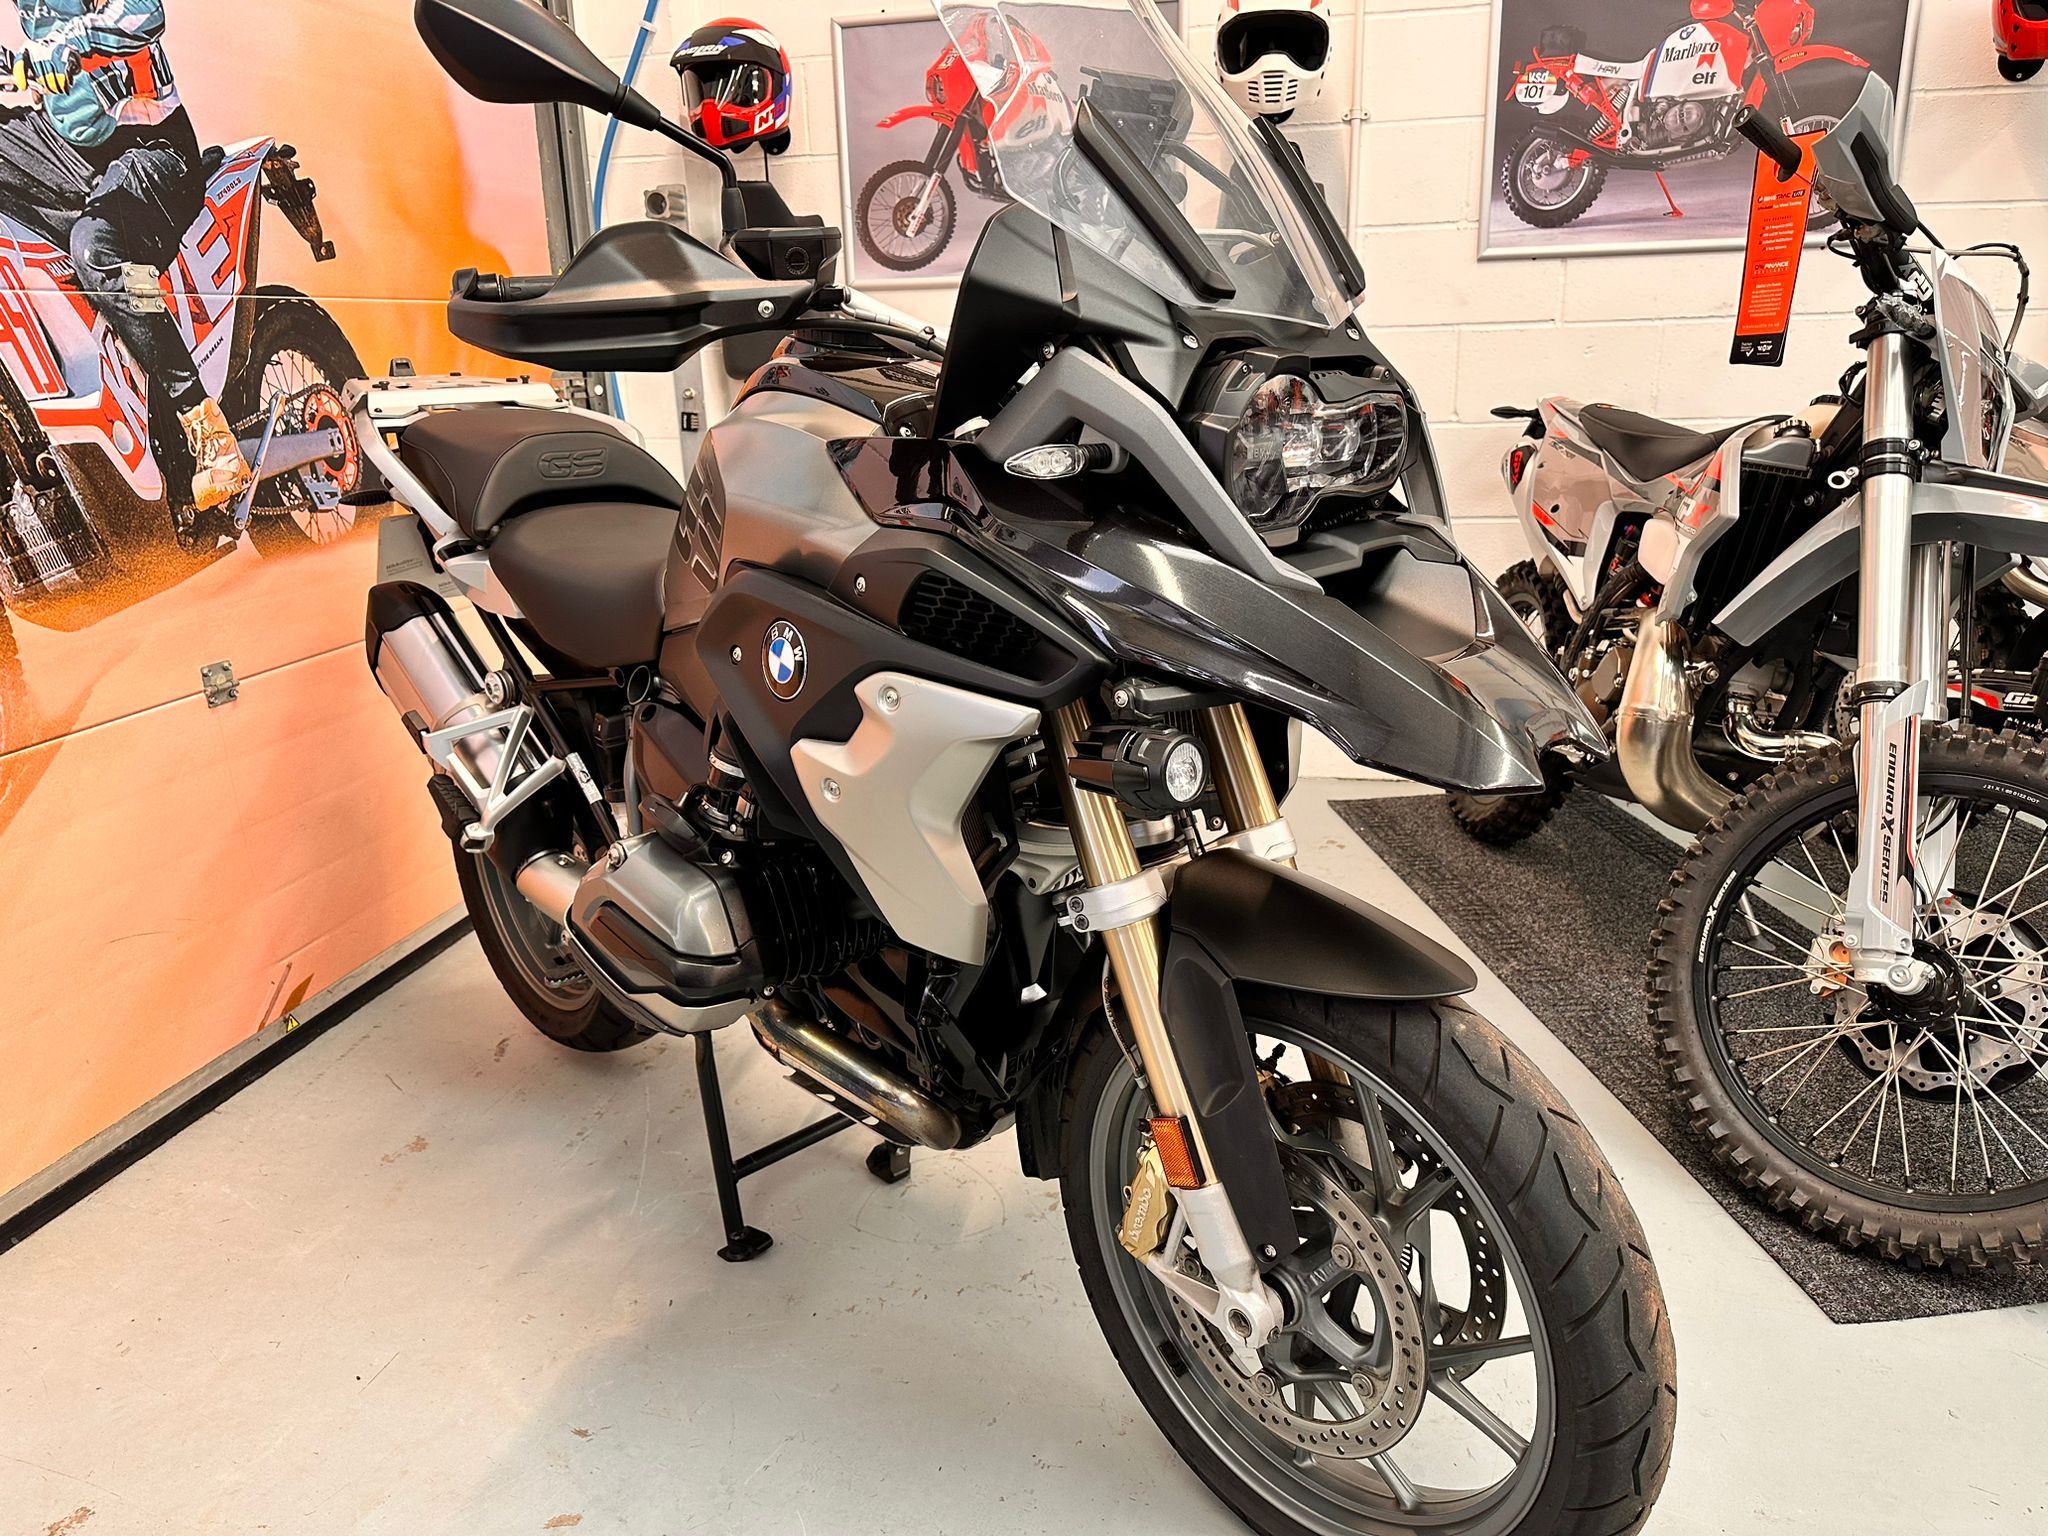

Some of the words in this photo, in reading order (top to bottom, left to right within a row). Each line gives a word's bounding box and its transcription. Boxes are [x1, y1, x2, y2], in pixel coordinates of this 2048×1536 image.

[1662, 41, 1719, 63] Marlboro
[1524, 85, 1544, 99] 101
[1692, 72, 1717, 85] elf
[540, 448, 605, 478] GS
[770, 626, 804, 661] BMW
[1885, 742, 1897, 815] ENDURO
[2026, 794, 2041, 804] DOT
[1879, 834, 1892, 904] SERIES
[1127, 1187, 1152, 1241] brembo
